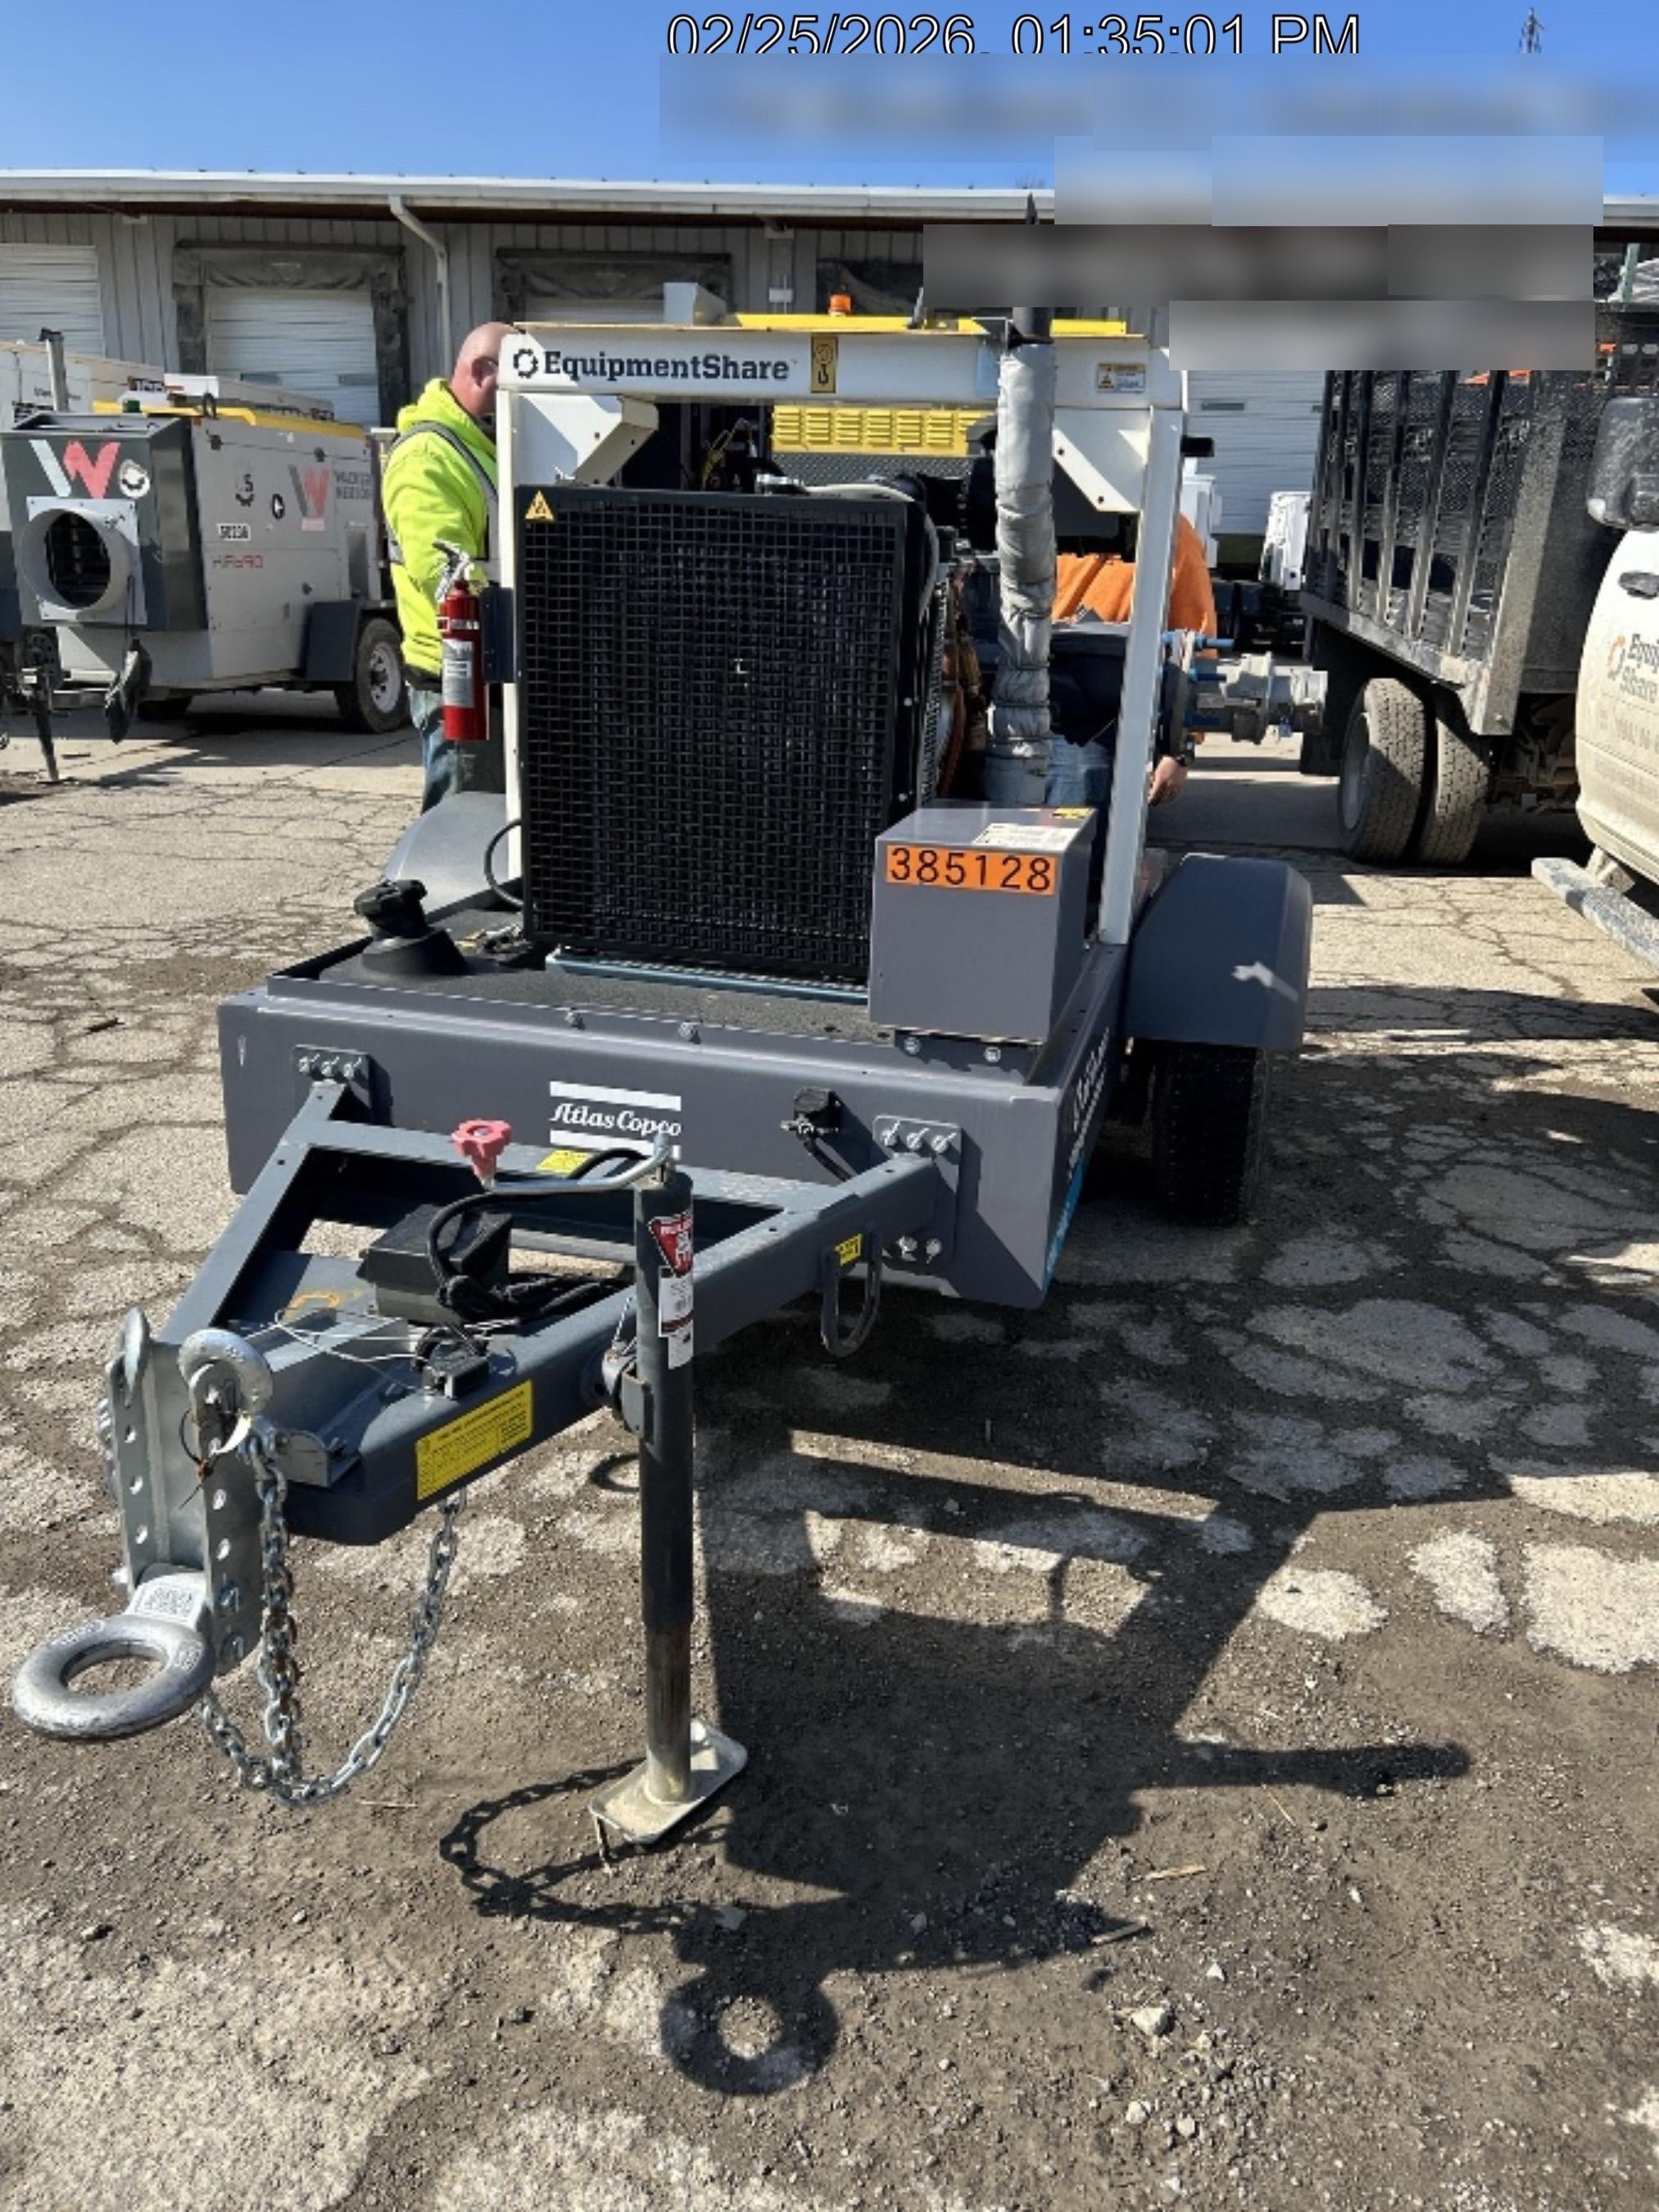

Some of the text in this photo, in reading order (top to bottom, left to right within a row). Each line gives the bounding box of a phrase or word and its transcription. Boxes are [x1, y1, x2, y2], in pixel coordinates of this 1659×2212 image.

[544, 351, 790, 382] EquipmentShare
[890, 846, 1051, 892] 385128
[550, 1103, 682, 1136] Atlas Copco
